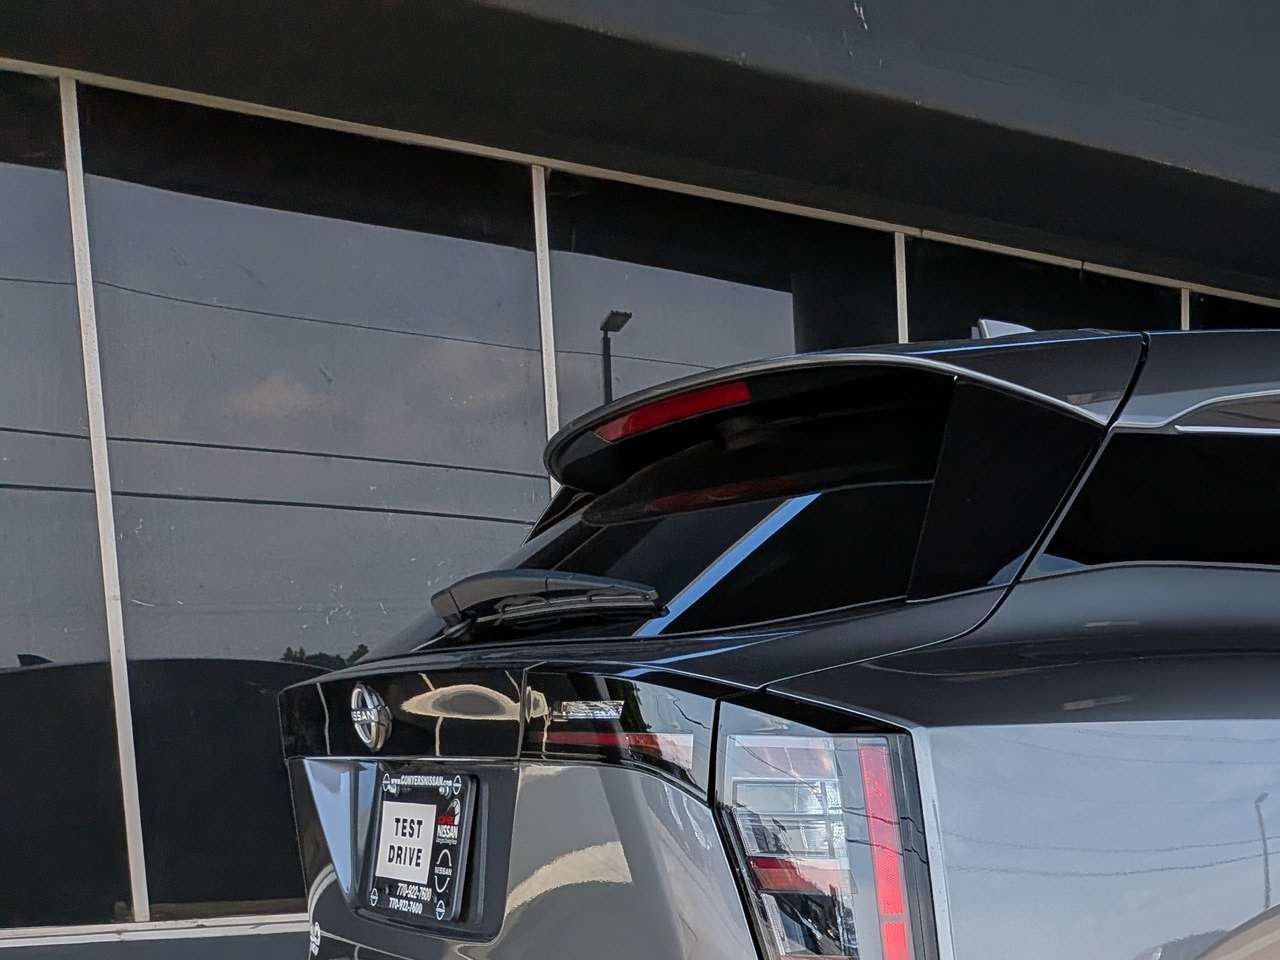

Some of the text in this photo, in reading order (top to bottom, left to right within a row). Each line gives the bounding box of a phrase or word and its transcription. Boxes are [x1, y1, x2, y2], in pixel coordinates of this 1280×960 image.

[351, 709, 379, 722] SSAN
[394, 817, 423, 839] TEST
[387, 844, 423, 868] DRIVE
[434, 866, 452, 876] NISSAN
[388, 897, 423, 915] 770-922-7600
